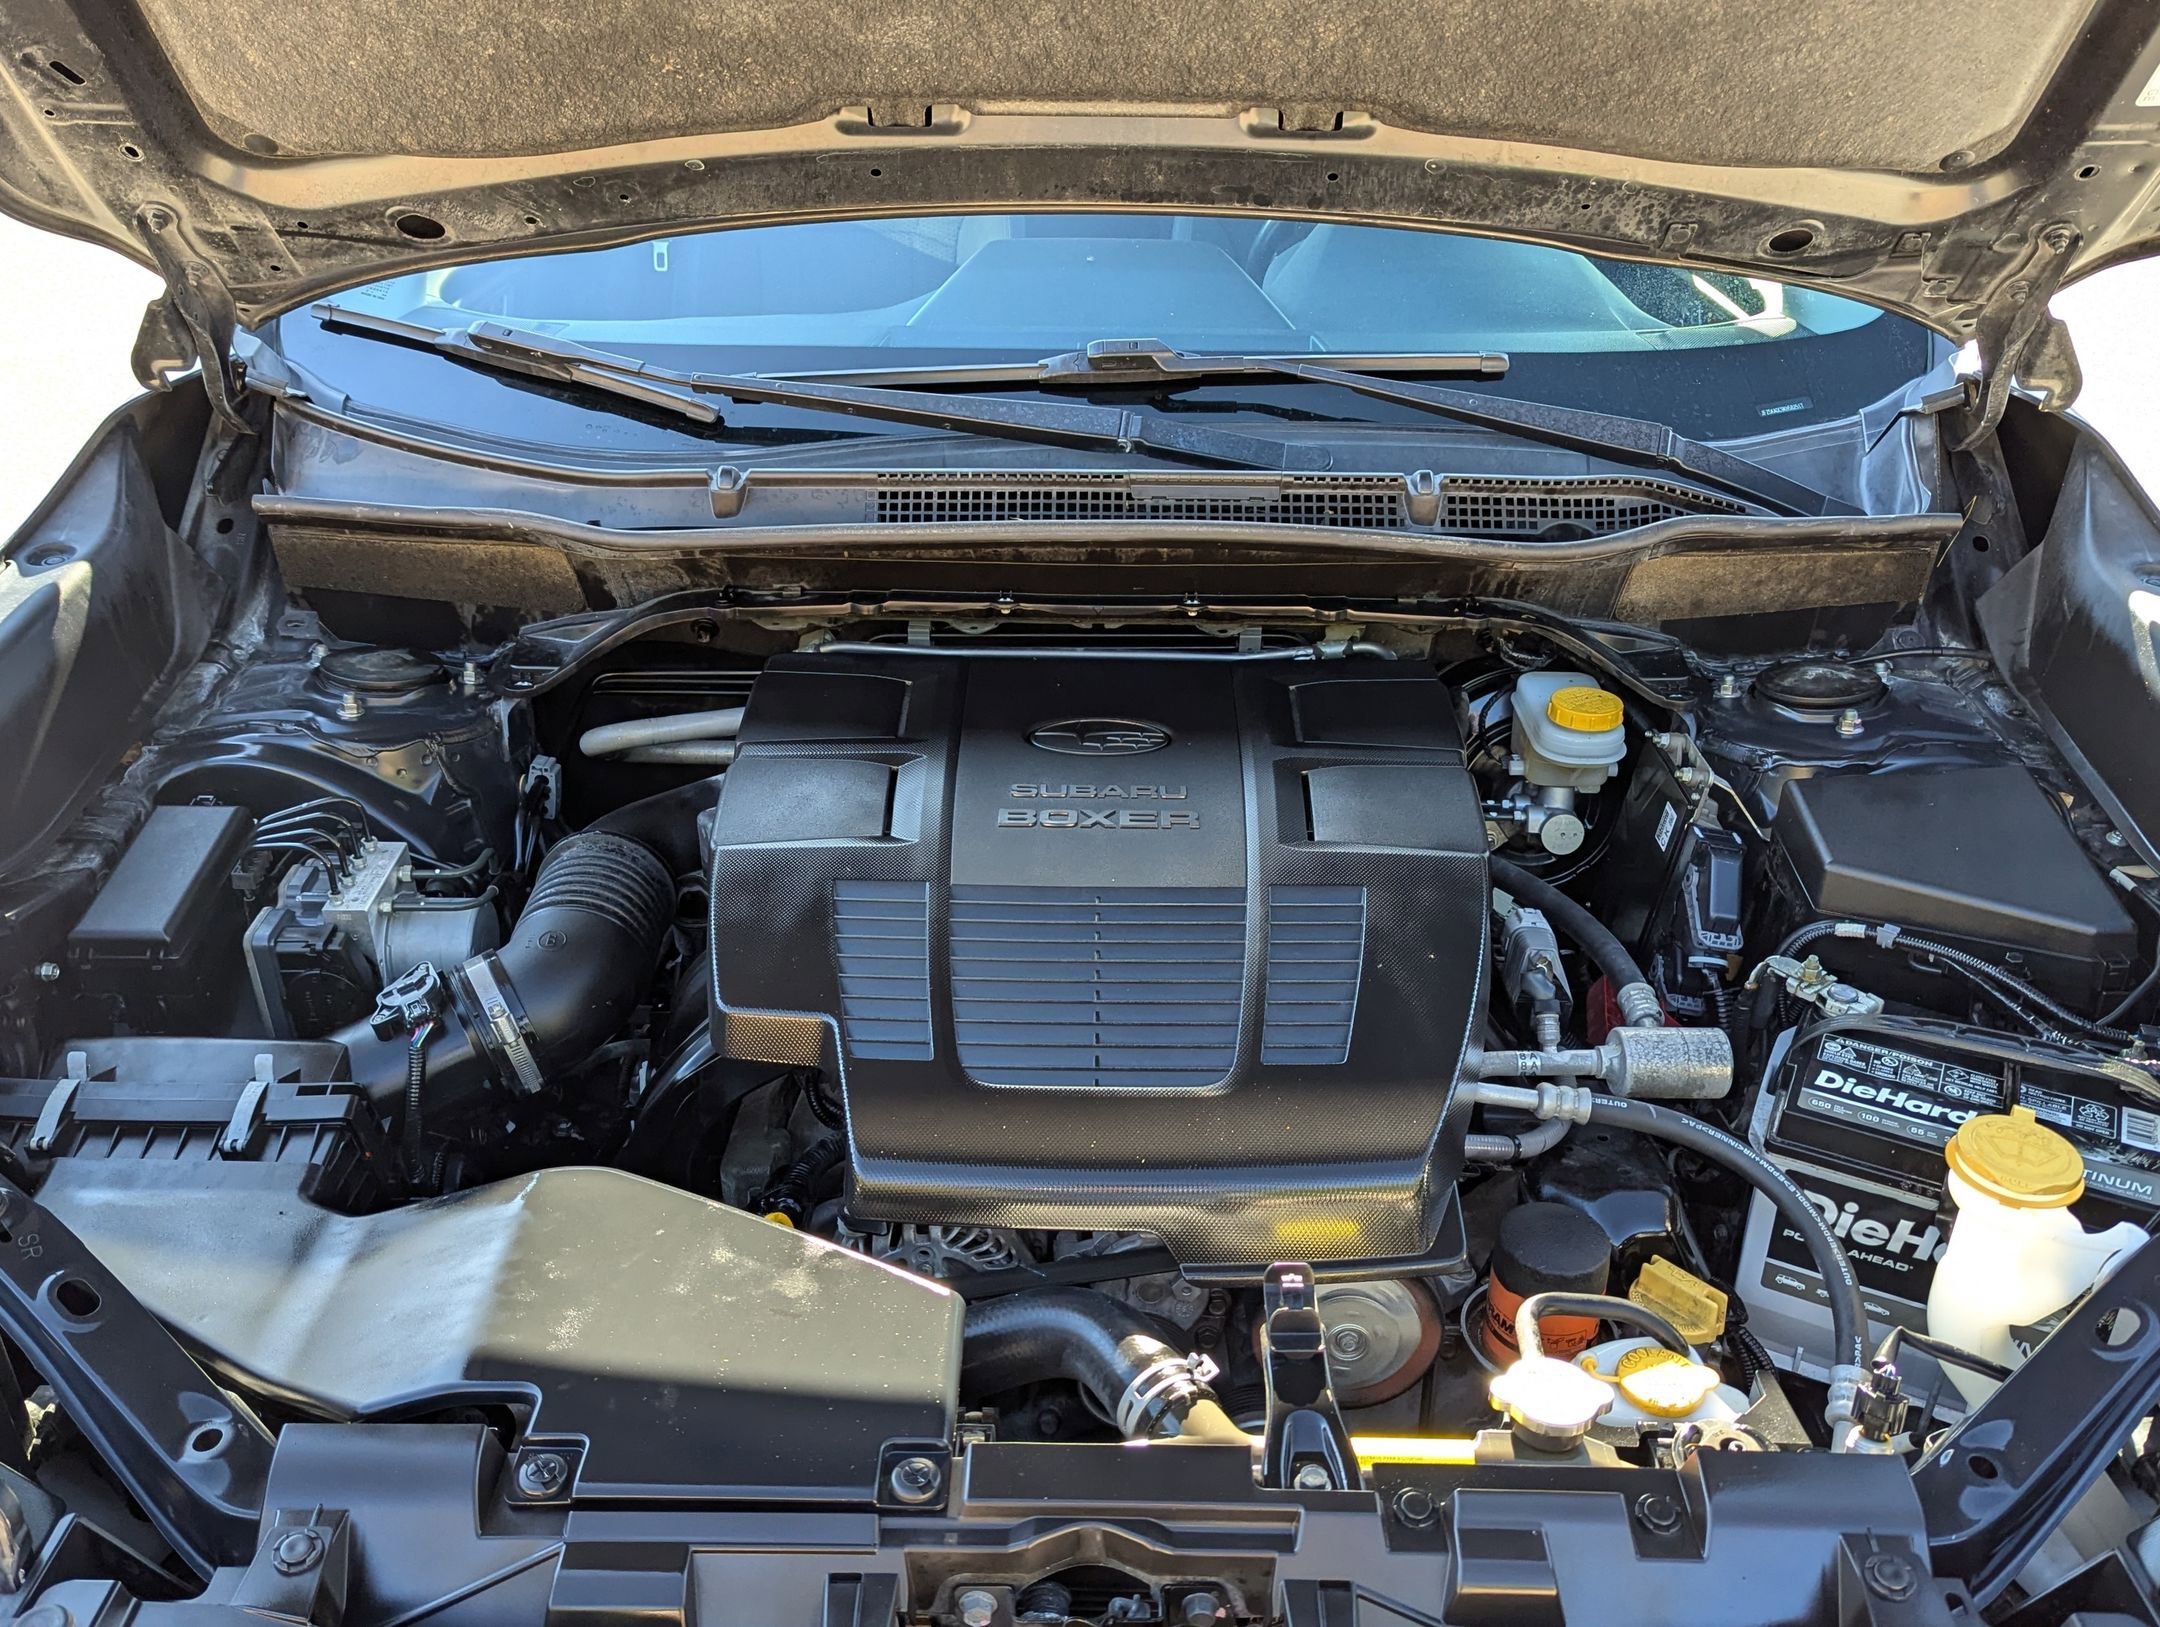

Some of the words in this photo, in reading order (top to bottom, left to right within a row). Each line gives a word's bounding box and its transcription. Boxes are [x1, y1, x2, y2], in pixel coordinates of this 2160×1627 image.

[1010, 783, 1188, 799] SUBARU
[998, 808, 1200, 829] BOXER
[1814, 1069, 1978, 1125] DieHard
[2083, 1169, 2153, 1195] TINUM
[1803, 1189, 1948, 1264] DieH
[1848, 1249, 1911, 1272] AHEAD
[1487, 1304, 1515, 1335] RAM
